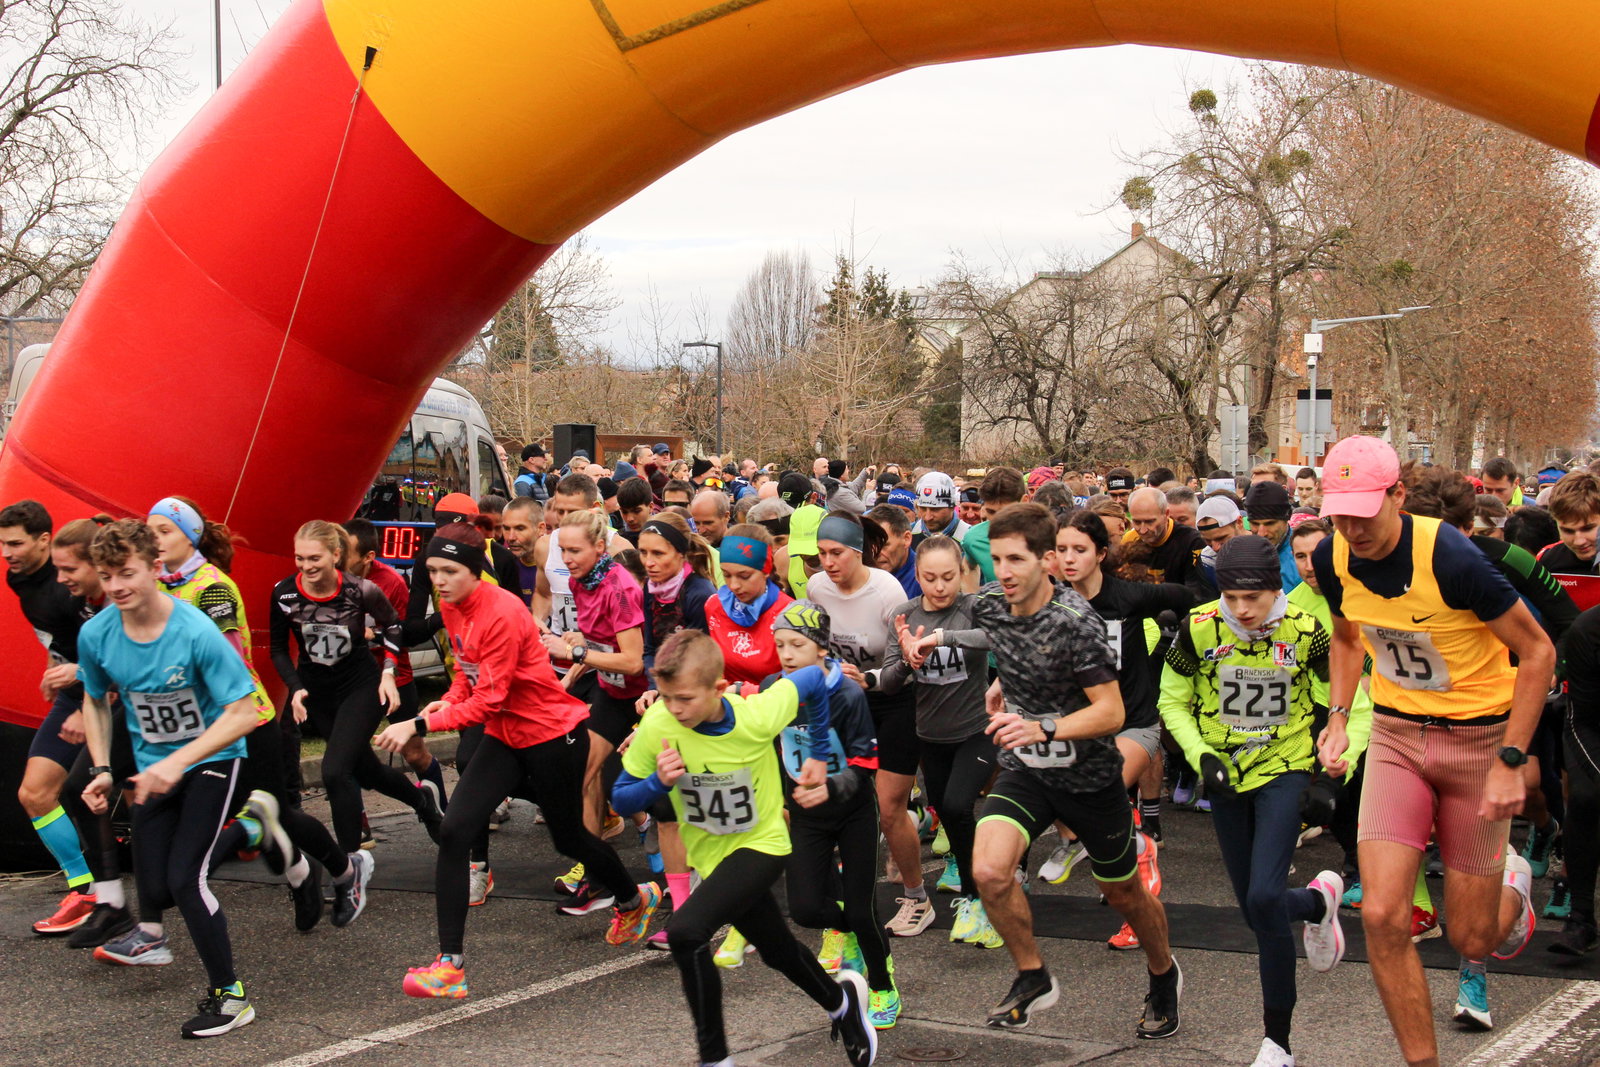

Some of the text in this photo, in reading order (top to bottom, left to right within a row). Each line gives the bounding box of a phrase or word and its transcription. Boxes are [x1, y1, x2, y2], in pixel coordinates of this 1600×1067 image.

[306, 634, 349, 659] 212
[1386, 642, 1432, 680] 15
[137, 699, 200, 733] 385
[1223, 681, 1286, 717] 223
[793, 750, 840, 774] 13
[681, 785, 753, 826] 343
